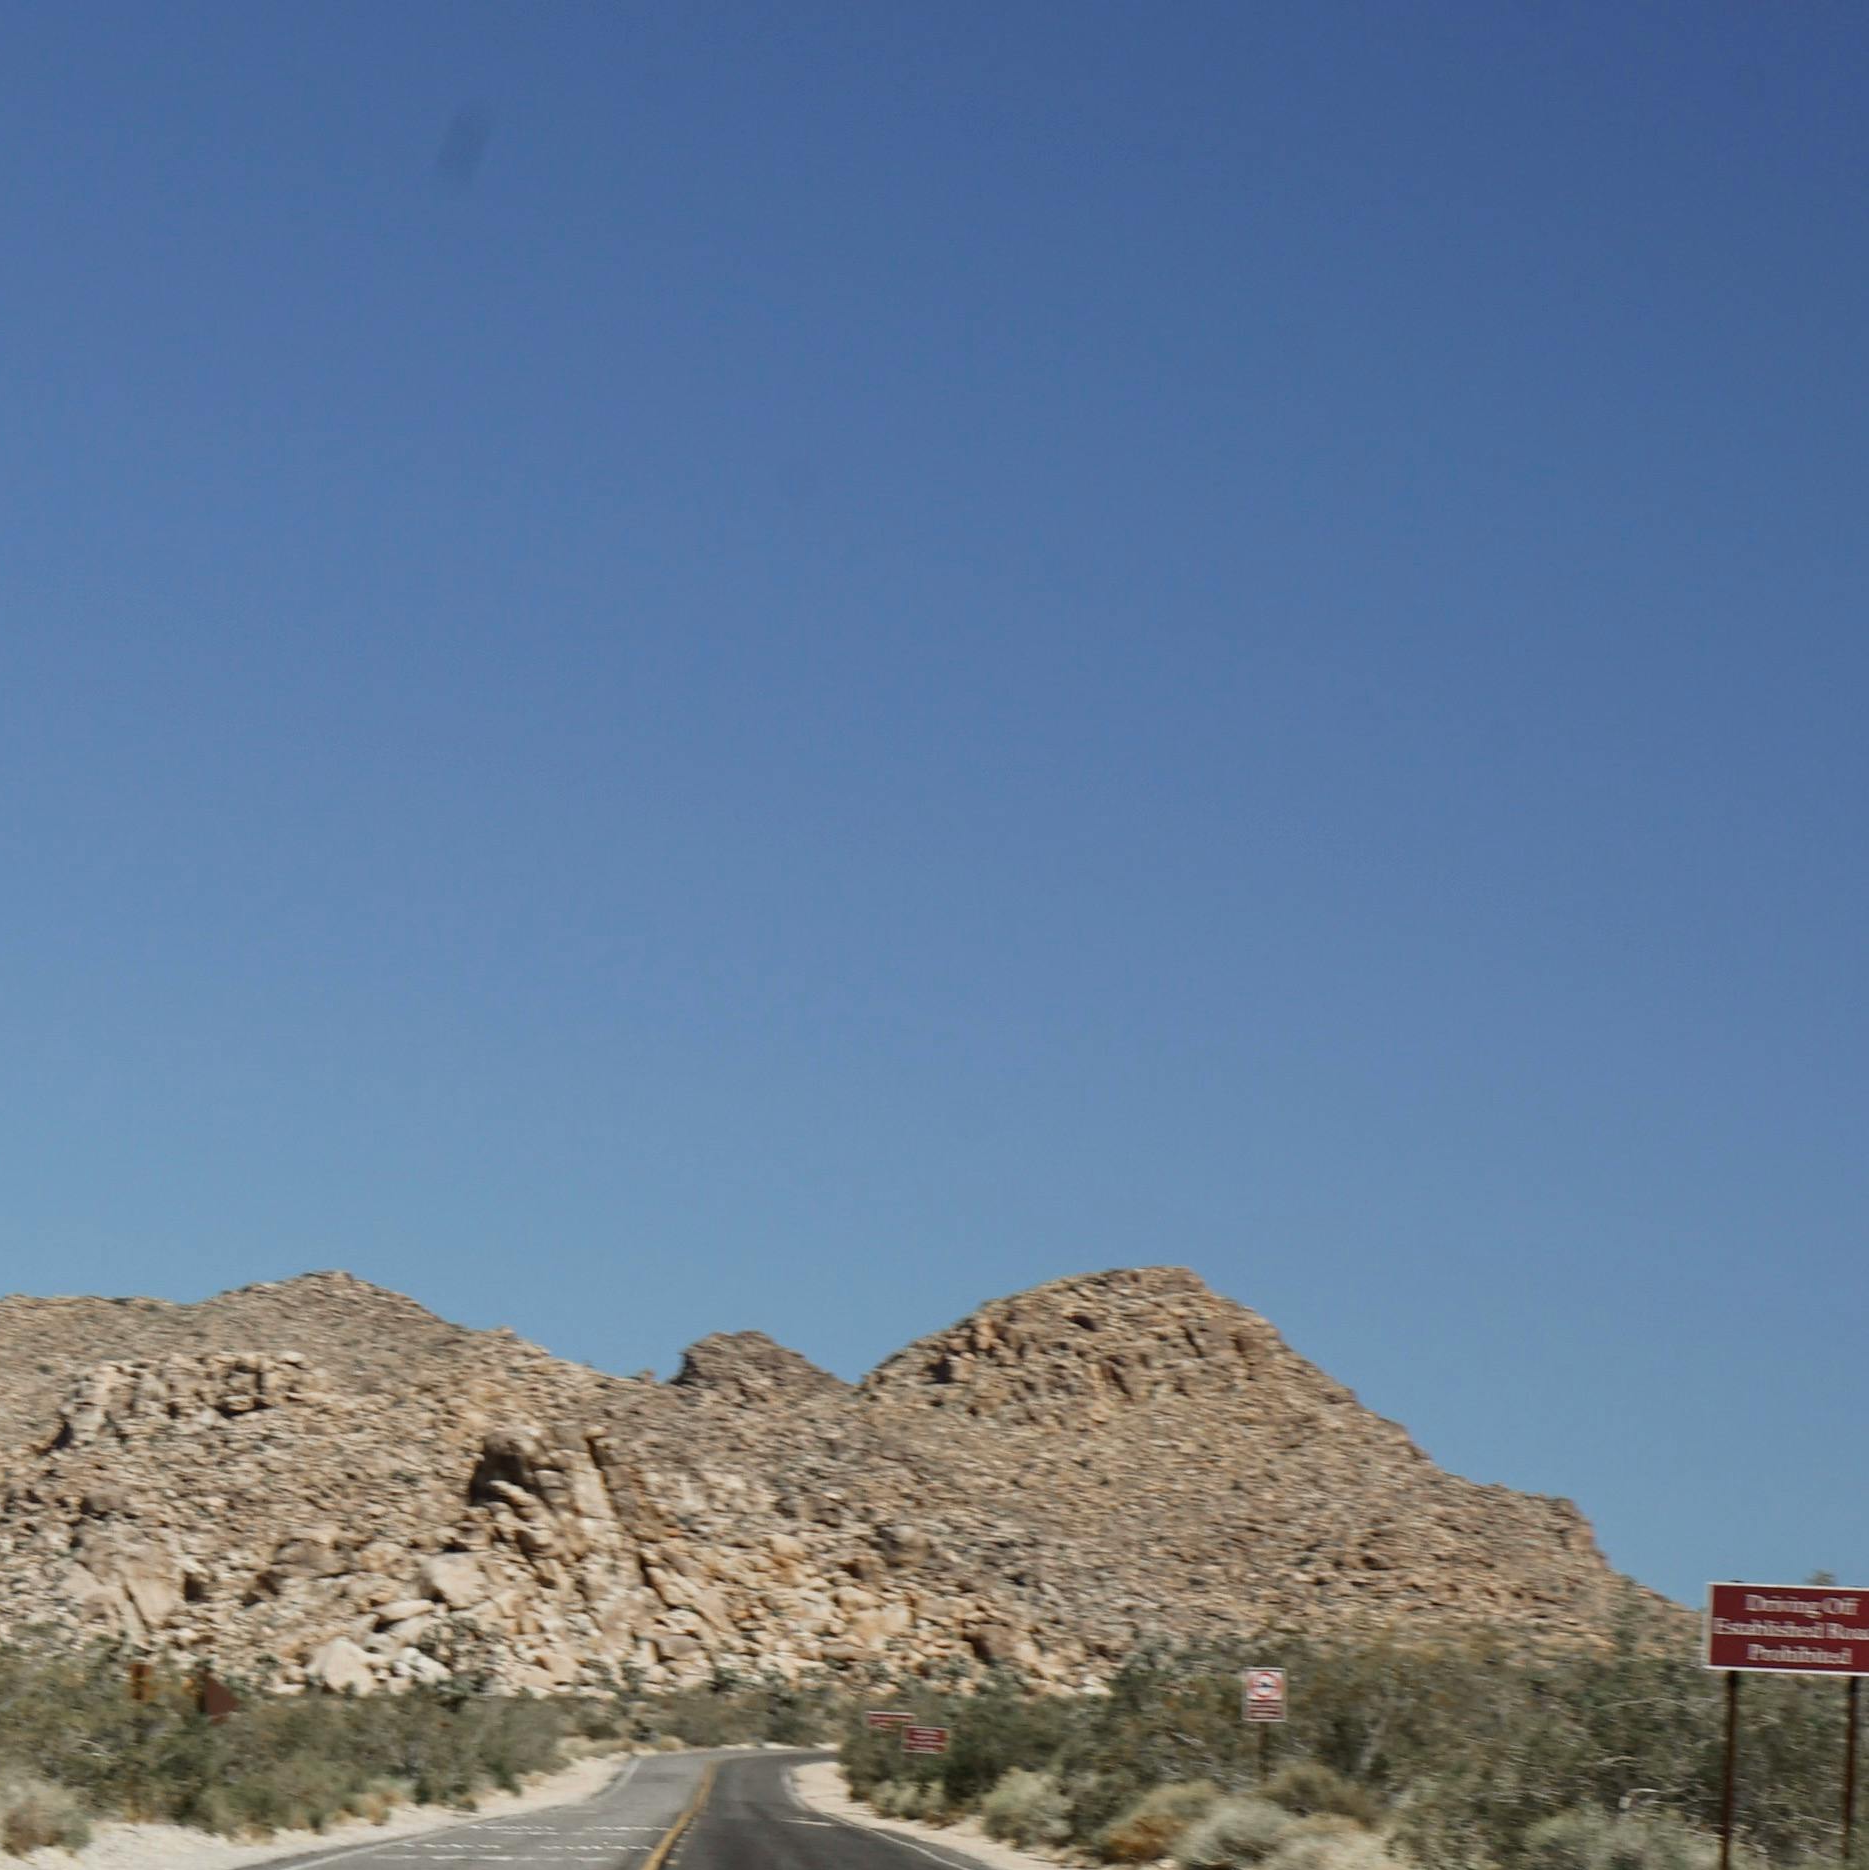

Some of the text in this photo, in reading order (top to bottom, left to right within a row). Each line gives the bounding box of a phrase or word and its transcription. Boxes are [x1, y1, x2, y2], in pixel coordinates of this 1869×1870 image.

[1745, 1594, 1823, 1619] Driving
[1713, 1617, 1825, 1639] Established
[1747, 1643, 1853, 1665] Prohibited
